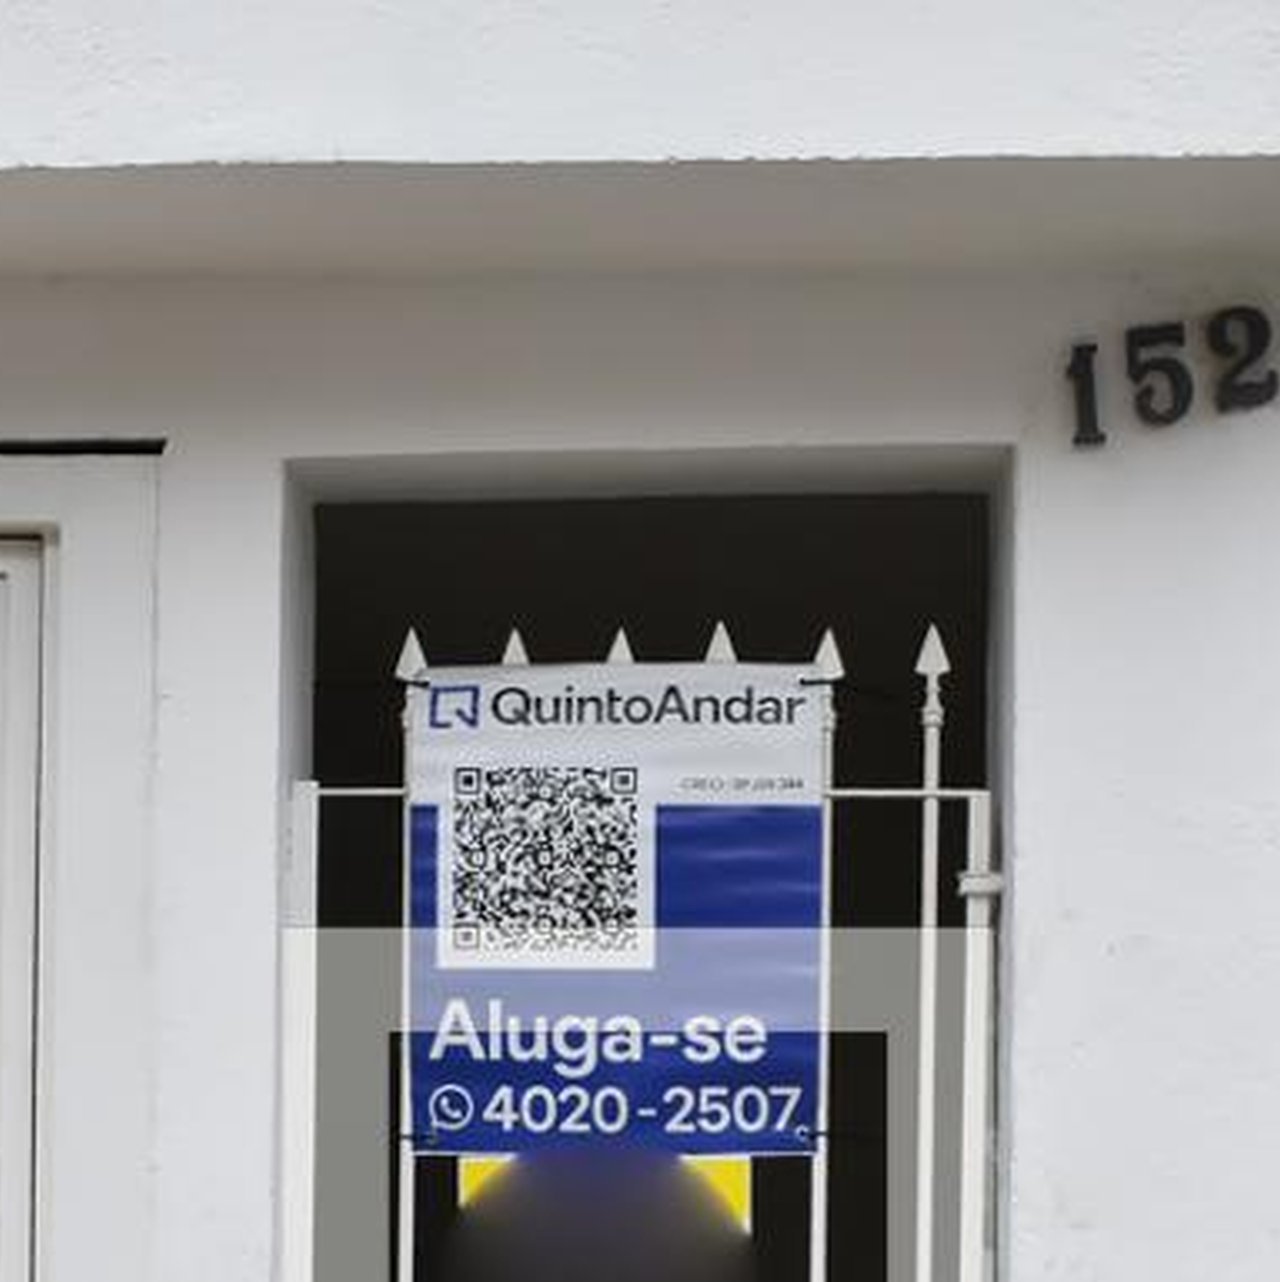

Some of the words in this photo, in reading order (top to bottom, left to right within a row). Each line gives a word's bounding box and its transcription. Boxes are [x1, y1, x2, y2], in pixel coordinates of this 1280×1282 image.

[1065, 304, 1280, 447] 152
[491, 685, 807, 726] QuintoAndar
[429, 999, 768, 1078] Aluga-se
